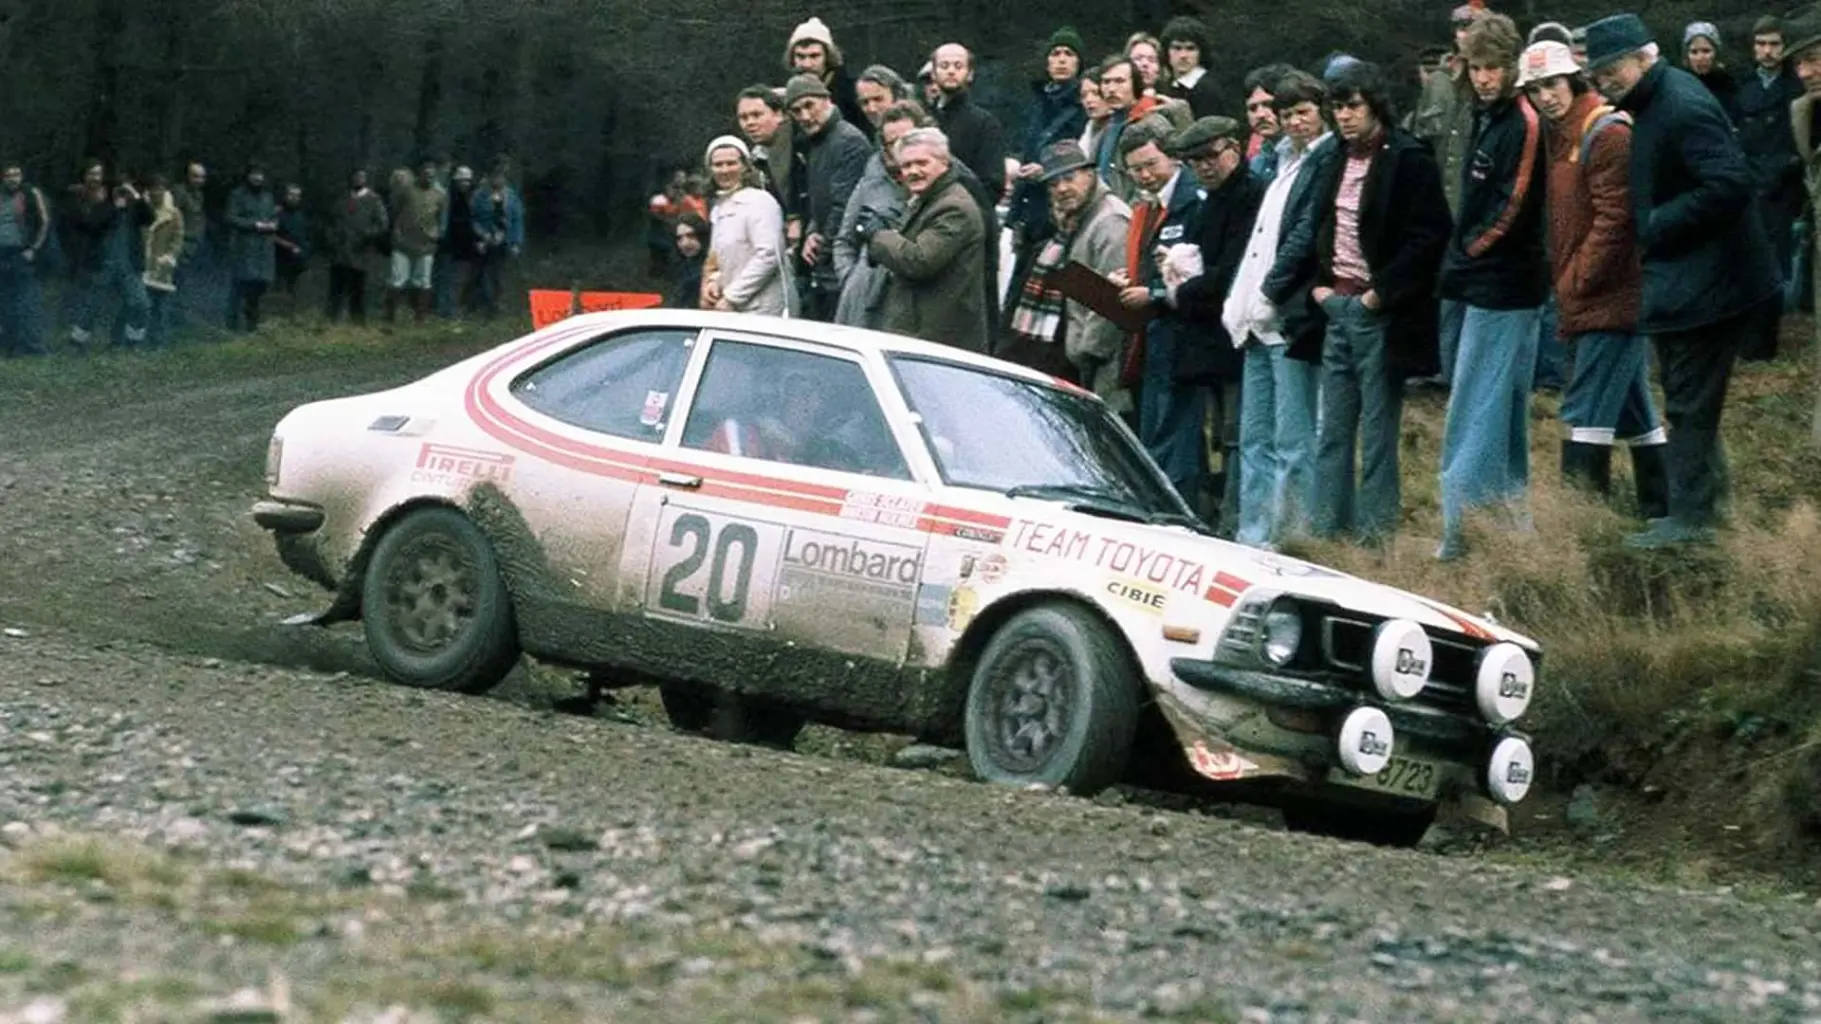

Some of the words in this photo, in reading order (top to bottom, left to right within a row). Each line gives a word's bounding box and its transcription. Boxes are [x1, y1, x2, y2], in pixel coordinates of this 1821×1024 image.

[415, 442, 516, 482] PIRELLI
[659, 512, 758, 622] 20
[783, 529, 921, 584] Lombard
[1012, 519, 1092, 561] TEAM
[1095, 537, 1205, 596] TOYOTA
